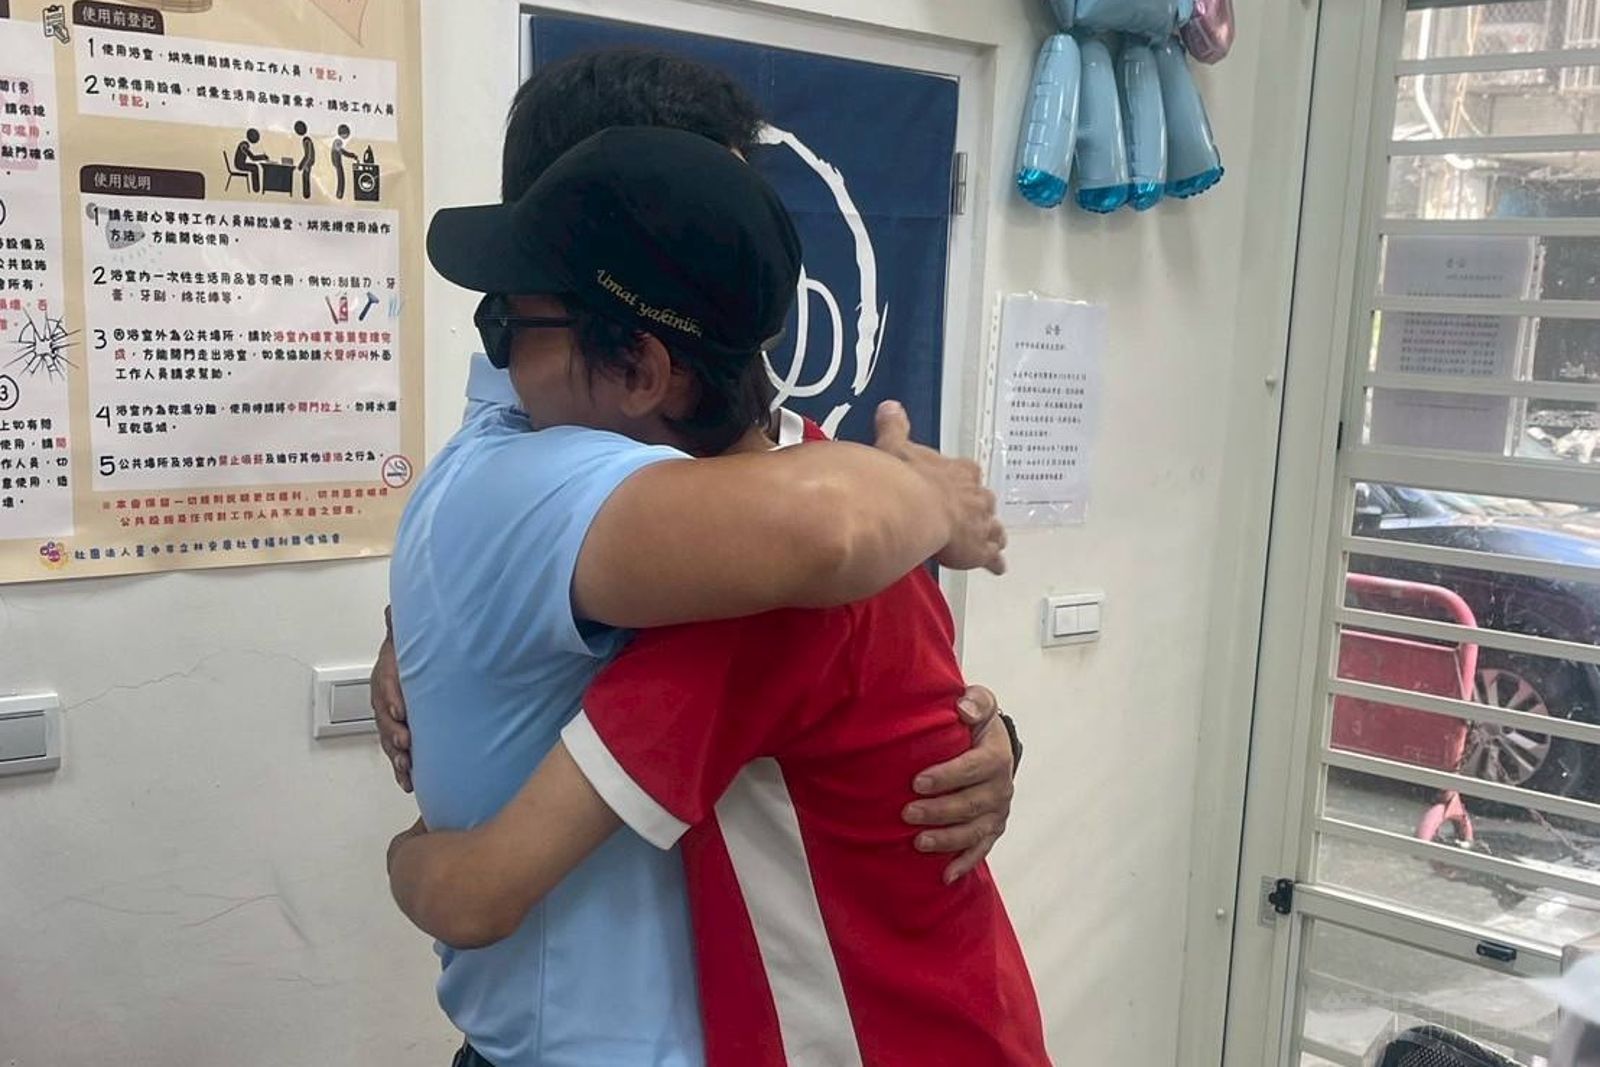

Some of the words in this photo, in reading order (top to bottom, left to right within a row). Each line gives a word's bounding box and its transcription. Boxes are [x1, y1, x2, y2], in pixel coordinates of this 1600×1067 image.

[81, 6, 157, 30] 使用前登記
[88, 38, 95, 57] 1
[84, 75, 100, 95] 2
[93, 172, 152, 190] 使用說明
[93, 207, 99, 226] 1
[92, 266, 107, 285] 2
[597, 269, 638, 306] Umai
[93, 329, 108, 349] 3
[95, 405, 111, 427] 4
[99, 456, 116, 477] 5
